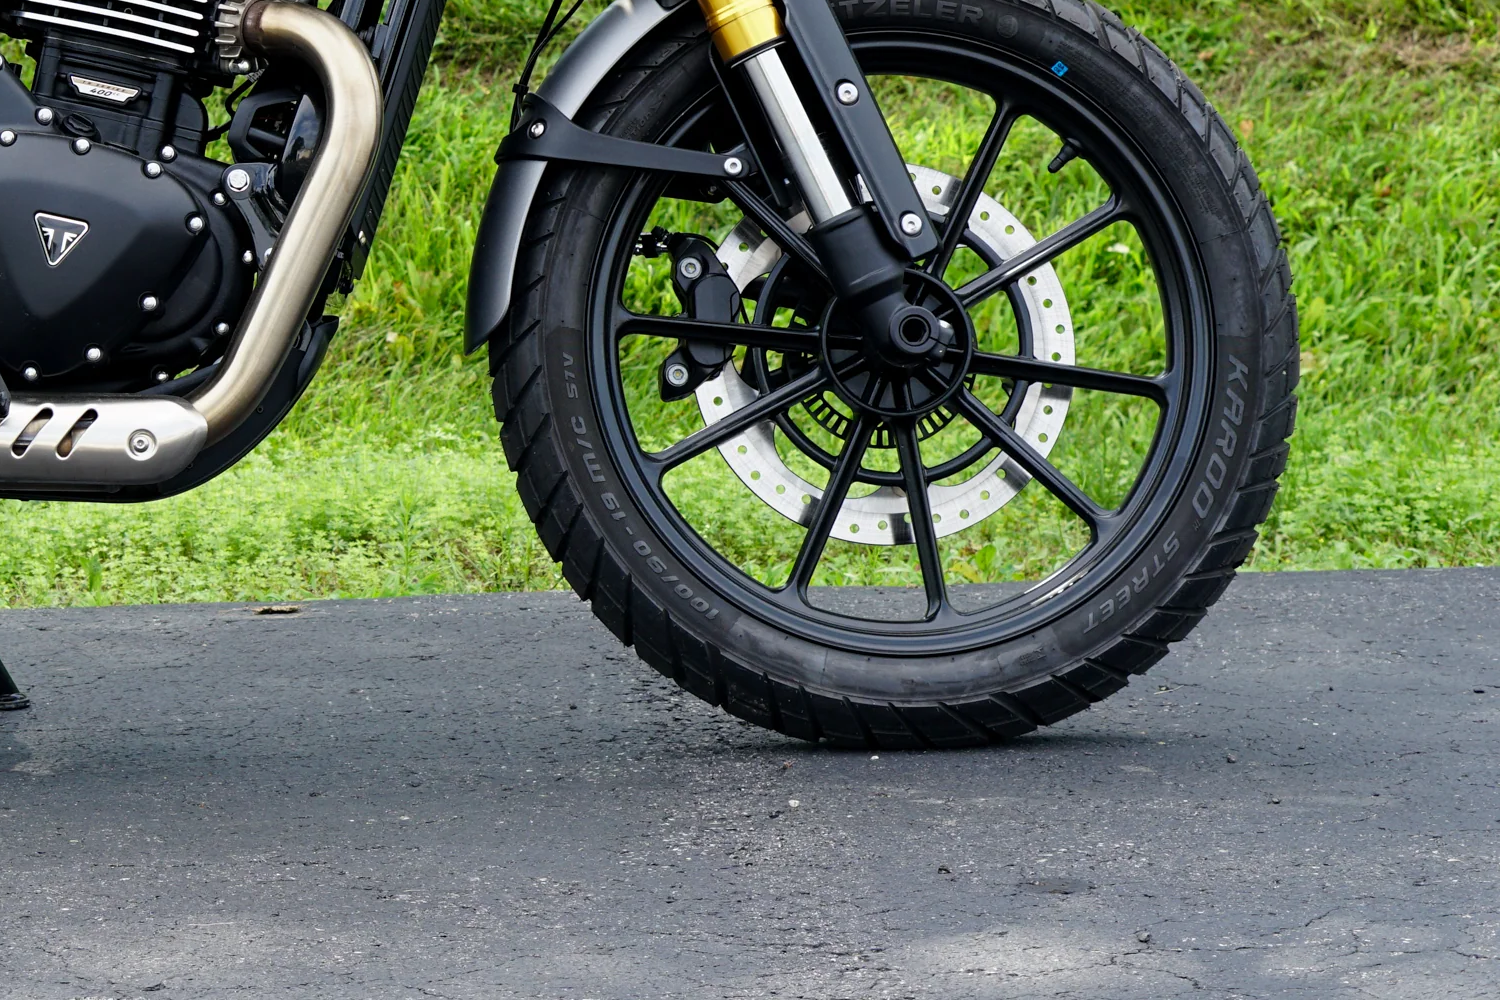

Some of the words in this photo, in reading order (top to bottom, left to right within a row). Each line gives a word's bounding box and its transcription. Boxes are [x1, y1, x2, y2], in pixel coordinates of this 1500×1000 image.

[562, 351, 579, 400] 57V
[570, 414, 607, 483] M/C
[1191, 352, 1249, 519] KAROO
[600, 491, 628, 521] 19
[632, 539, 721, 621] 100/90
[1083, 530, 1181, 635] STREET
